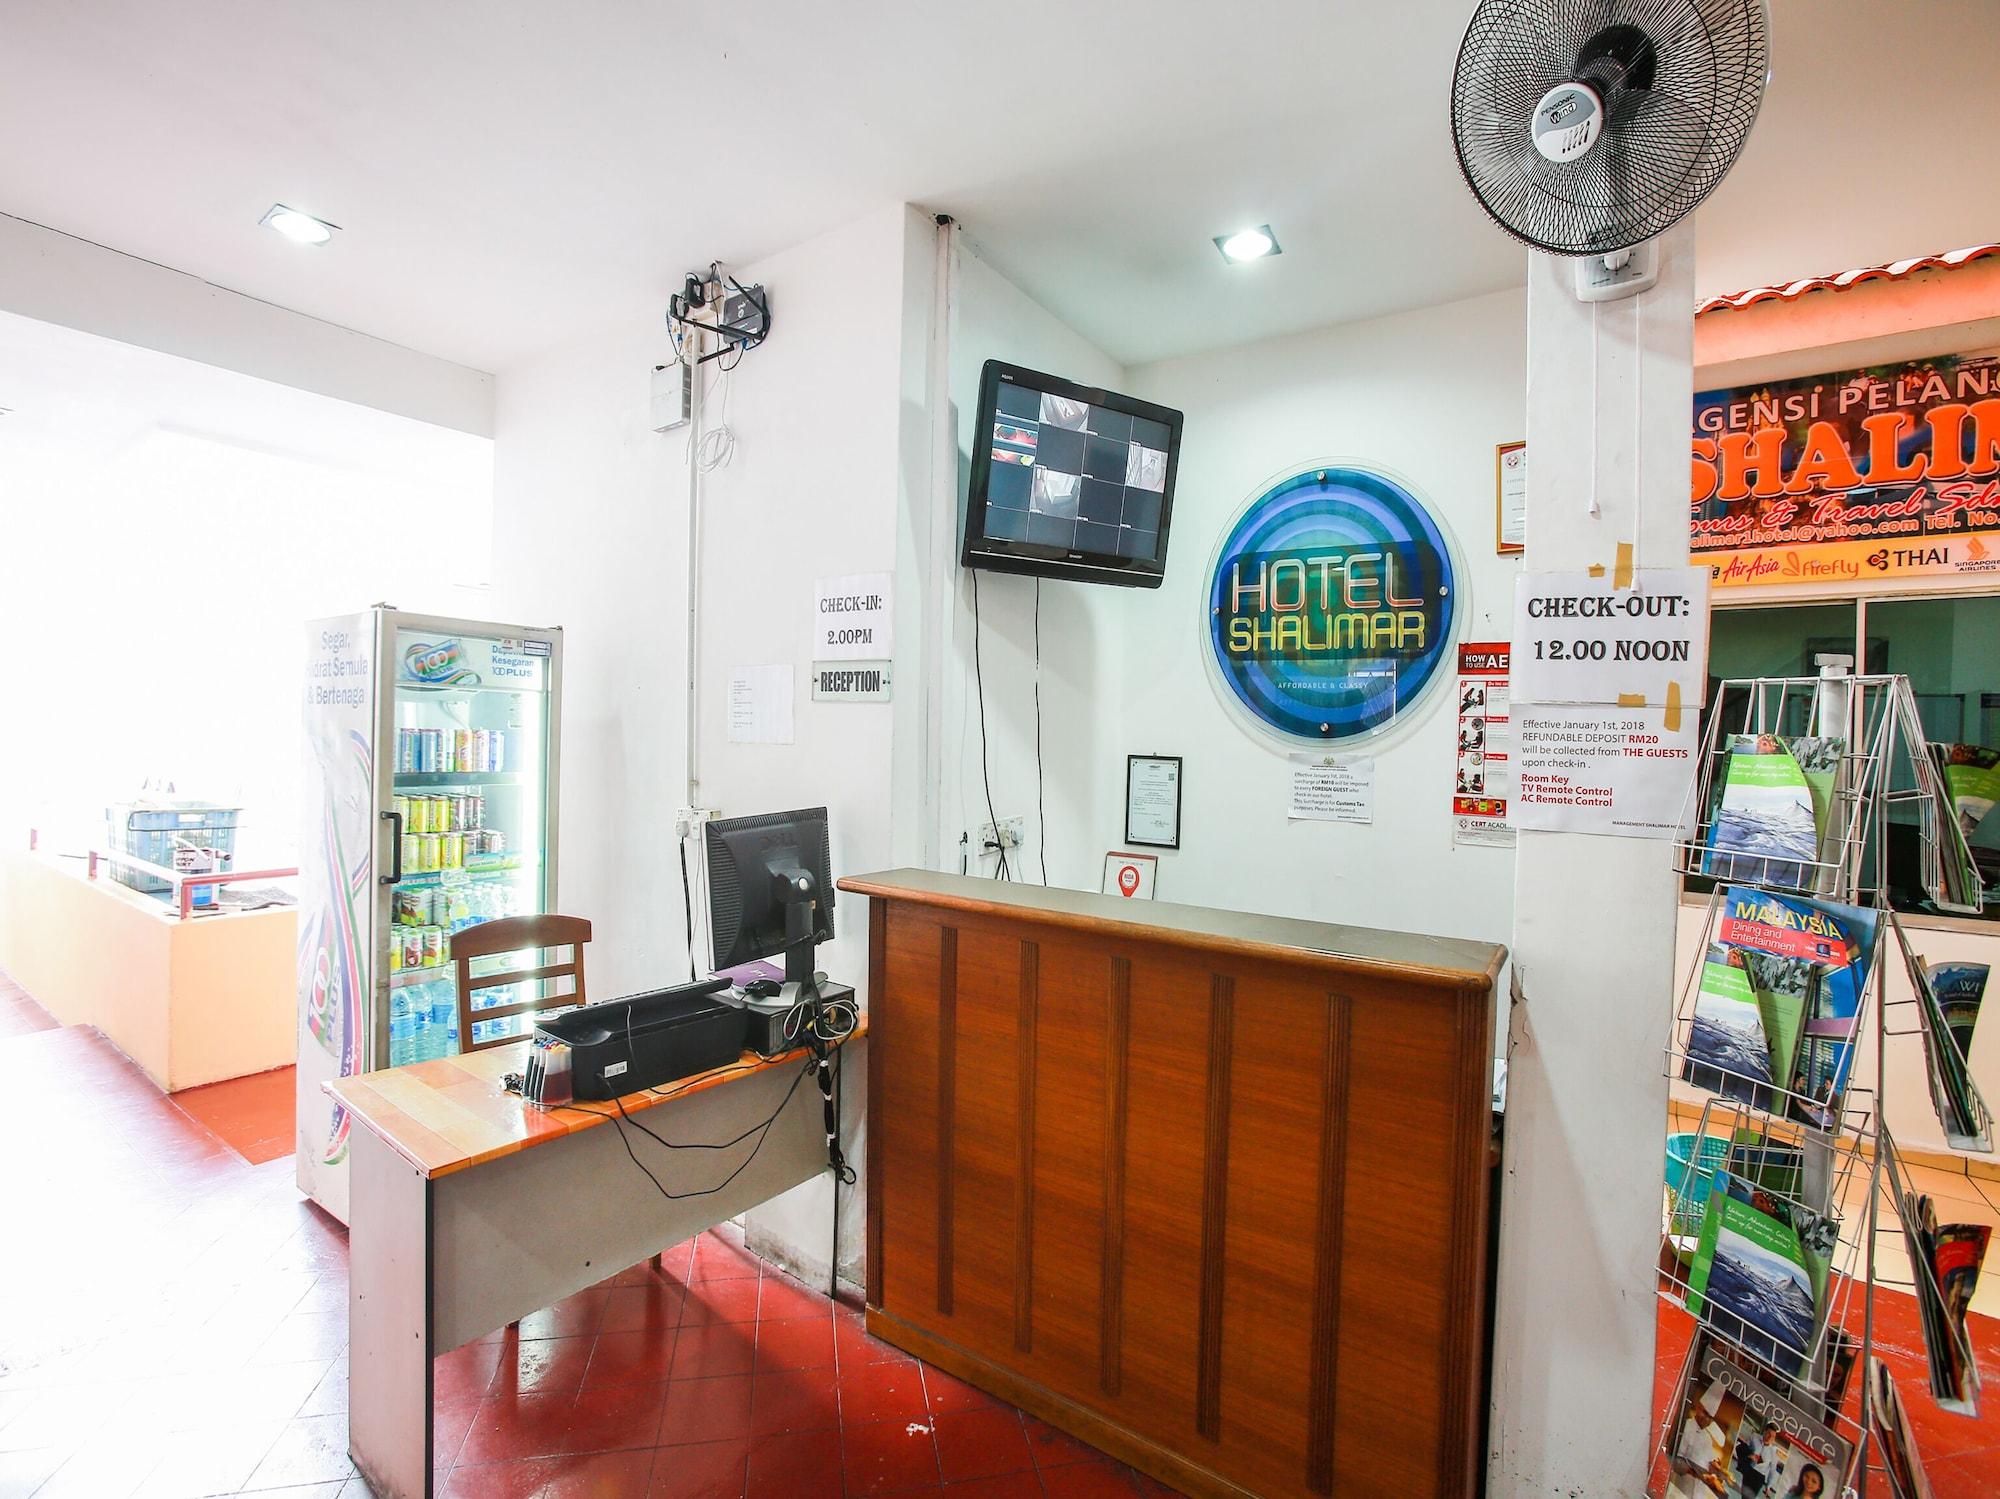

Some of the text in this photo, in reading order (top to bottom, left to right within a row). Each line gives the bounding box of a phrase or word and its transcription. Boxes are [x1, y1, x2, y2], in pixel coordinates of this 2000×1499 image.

[1838, 367, 2000, 414] PELAN
[1761, 500, 1798, 527] &
[1809, 487, 1927, 524] Travel
[1925, 511, 1961, 530] Tel.
[1893, 547, 1949, 567] THAI
[1232, 552, 1424, 613] HOTEL
[820, 595, 882, 613] CHECK-IN:
[1528, 595, 1690, 618] CHECK-OUT:
[827, 628, 872, 645] 2.00PM
[1229, 611, 1425, 651] SHALIMAR
[1465, 655, 1486, 663] HOW
[1534, 640, 1690, 661] 12.00 NOON
[492, 656, 534, 667] Kesegaran
[820, 671, 880, 692] RECEPTION
[1523, 719, 1645, 732] Effective January 1st, 2018
[1522, 732, 1658, 744] REFUNDABLE DEPOSIT RM20
[1522, 745, 1688, 758] will be collected from THE GUESTS
[1522, 760, 1545, 769] upon
[1521, 774, 1569, 785] Room Key
[1521, 784, 1612, 796] TV Remote Control
[1520, 794, 1612, 807] AC Remote Control
[1732, 920, 1783, 939] Dining and
[1735, 901, 1843, 940] MALAYSIA
[1731, 930, 1796, 952] Entertainment
[1706, 1357, 1836, 1457] Convergence
